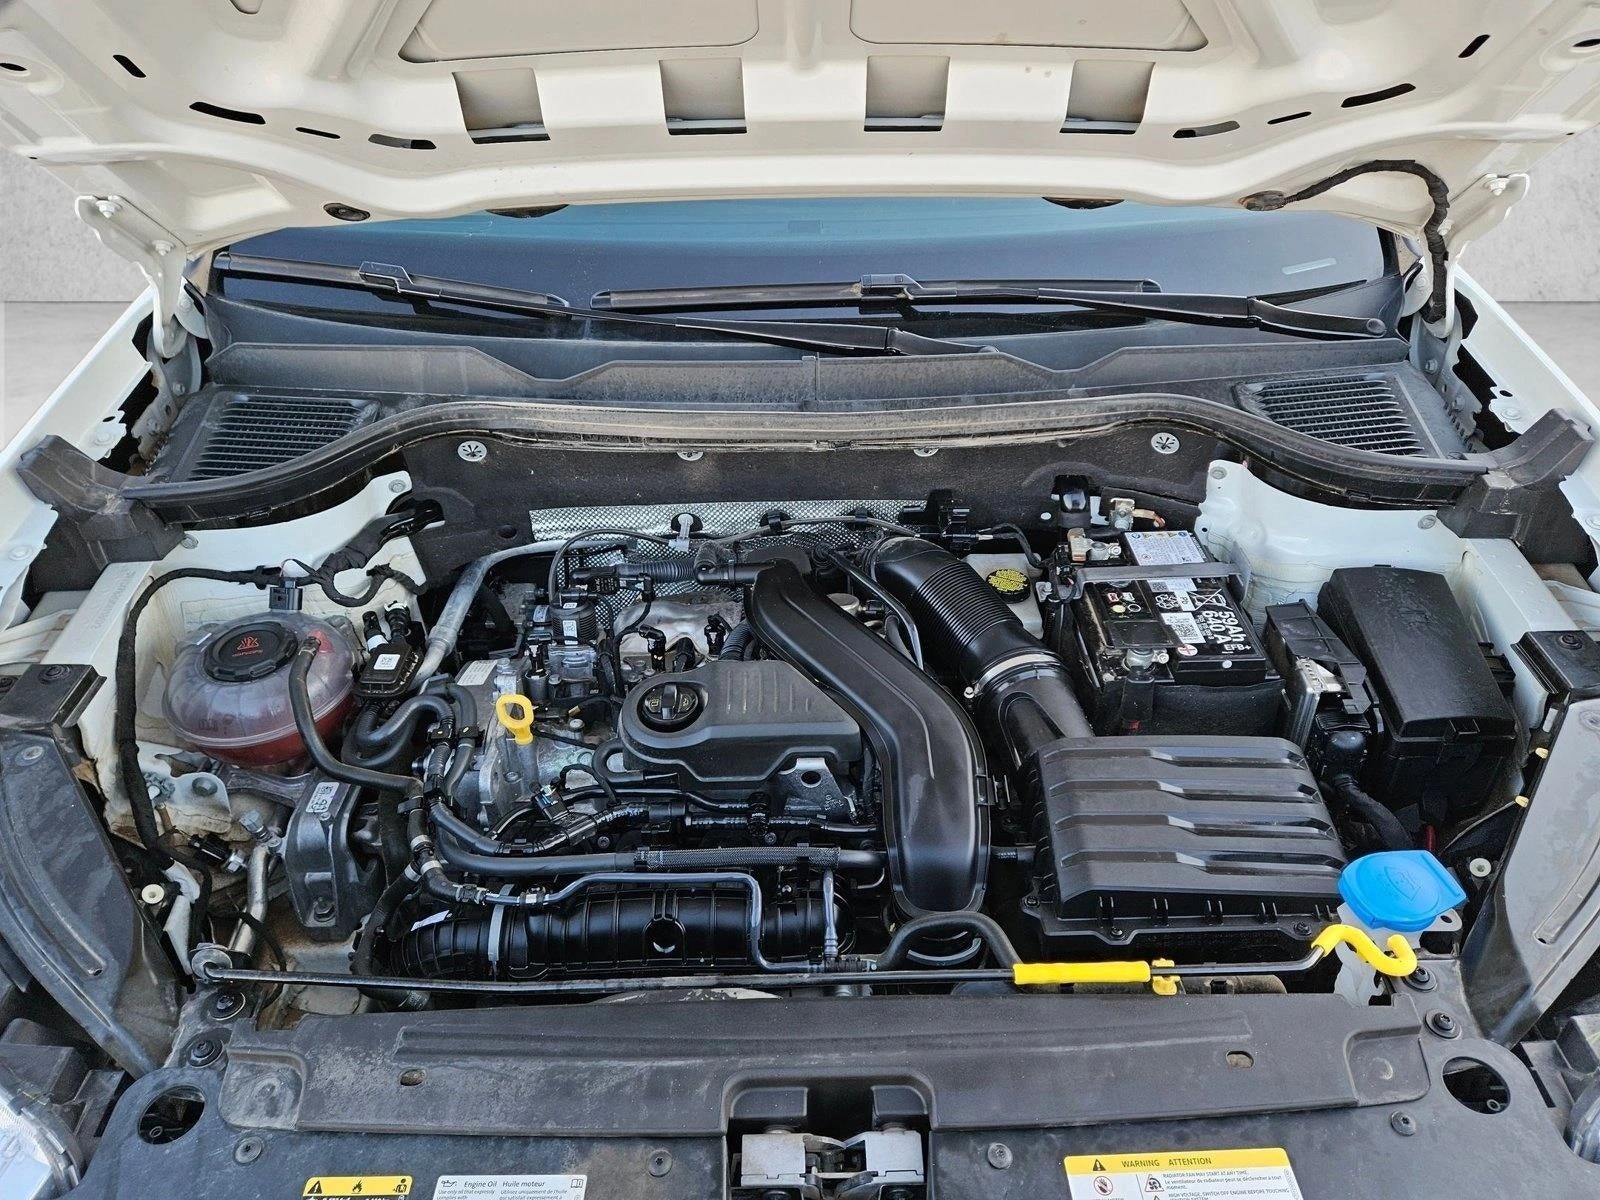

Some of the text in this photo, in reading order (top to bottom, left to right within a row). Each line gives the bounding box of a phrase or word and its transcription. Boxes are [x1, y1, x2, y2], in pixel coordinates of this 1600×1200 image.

[1201, 610, 1226, 632] 640
[1218, 611, 1247, 642] 59Ah
[1213, 634, 1232, 644] A
[1223, 643, 1251, 651] EFB+
[1121, 1157, 1212, 1167] WARNING ATTENTION
[464, 1180, 498, 1190] Engine Oil
